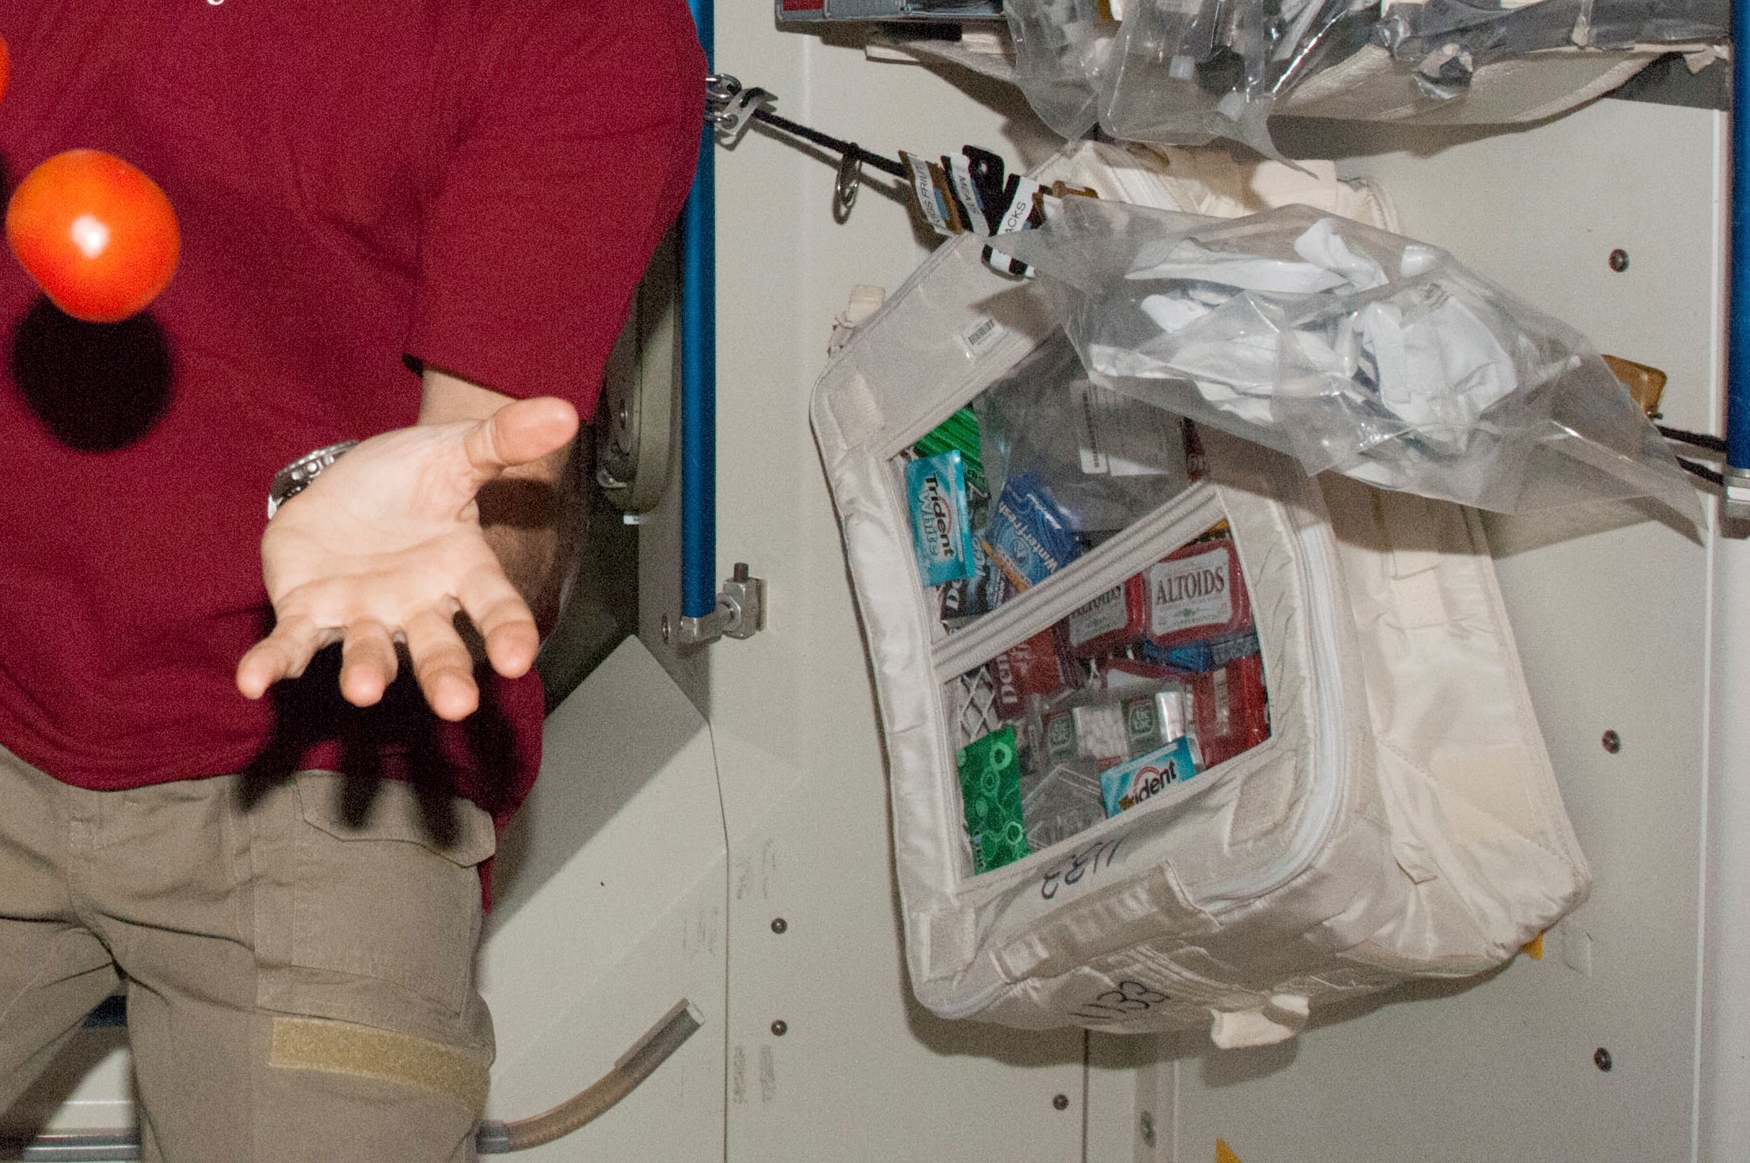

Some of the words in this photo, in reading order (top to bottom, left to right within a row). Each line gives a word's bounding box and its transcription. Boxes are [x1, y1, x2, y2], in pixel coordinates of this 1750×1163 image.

[925, 472, 954, 558] Trident
[1157, 566, 1224, 605] ALTOIDS
[1042, 830, 1132, 900] 1133
[1068, 980, 1171, 1019] 1133
